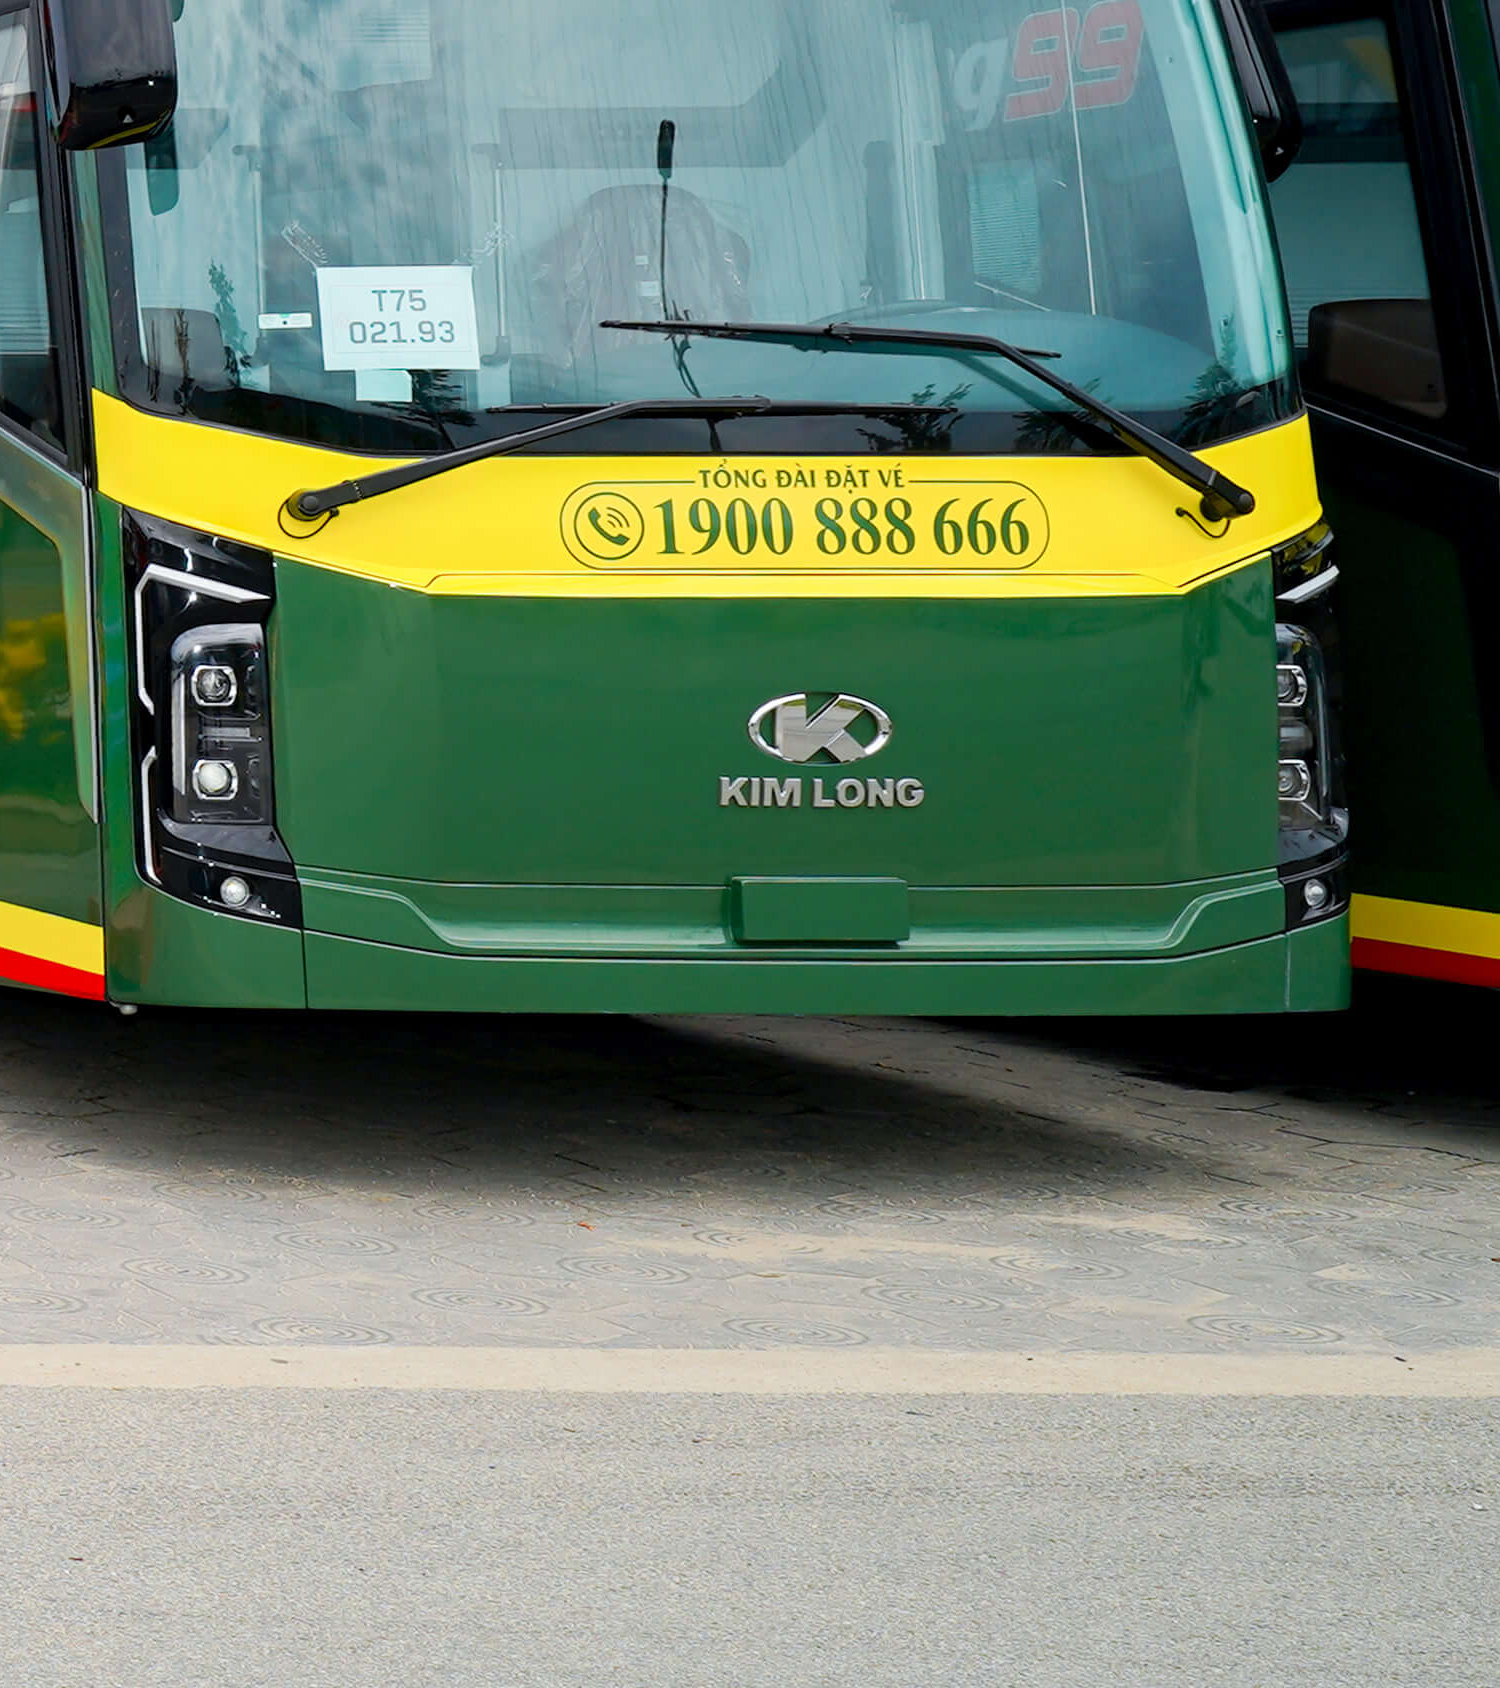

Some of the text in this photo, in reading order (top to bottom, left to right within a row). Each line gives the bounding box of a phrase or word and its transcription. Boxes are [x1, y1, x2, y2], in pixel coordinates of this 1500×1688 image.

[371, 288, 426, 313] T75
[349, 319, 455, 345] 021.93
[699, 459, 906, 494] TỔNG ĐÀI ĐẶT VÉ
[656, 497, 1031, 556] 1900 888 666
[719, 776, 925, 809] KIM LONG
